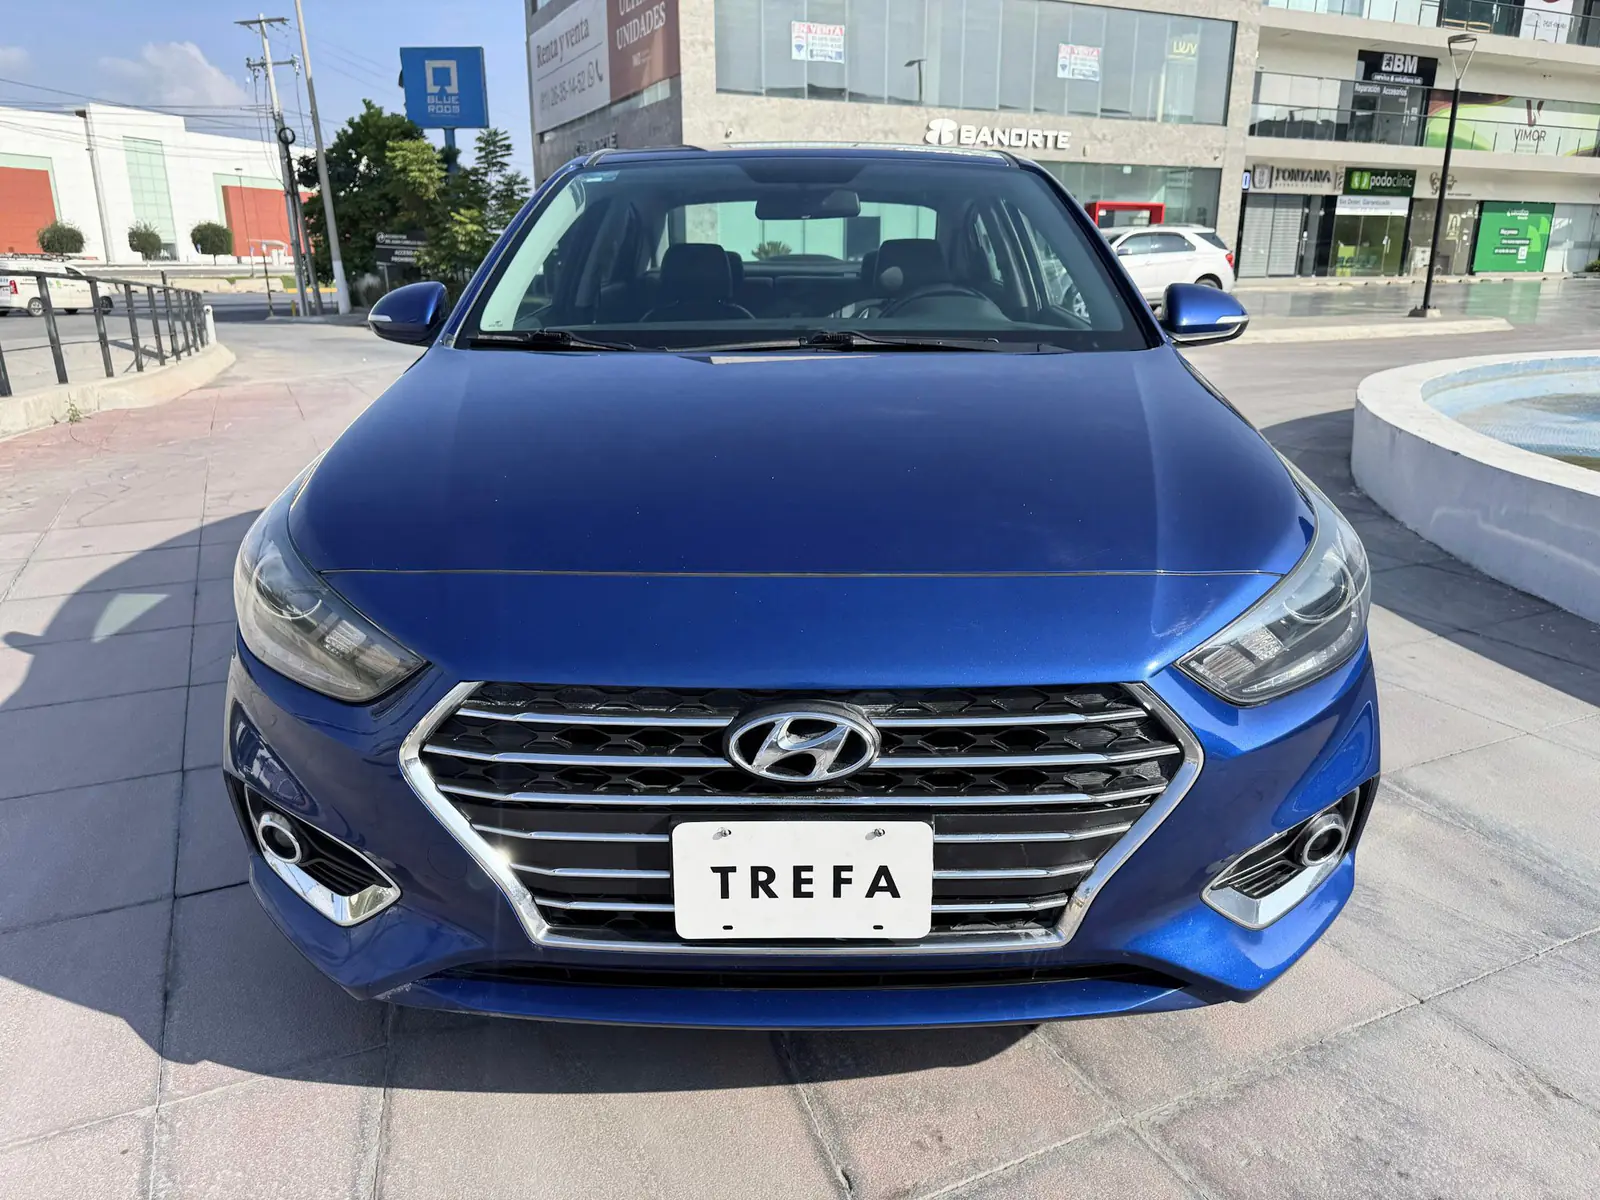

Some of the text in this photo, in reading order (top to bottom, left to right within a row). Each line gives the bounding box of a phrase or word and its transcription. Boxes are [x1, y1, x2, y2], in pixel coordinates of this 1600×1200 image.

[616, 1, 666, 49] UNIDADES
[536, 38, 558, 68] Renta
[565, 18, 589, 49] venta
[1354, 82, 1380, 93] Reparación
[427, 95, 460, 104] BLUE
[428, 105, 460, 114] ROOM
[959, 125, 1072, 149] BANORTE
[1514, 128, 1547, 142] VIMOR
[1275, 168, 1332, 183] FONTANA
[710, 865, 901, 900] TREFA
